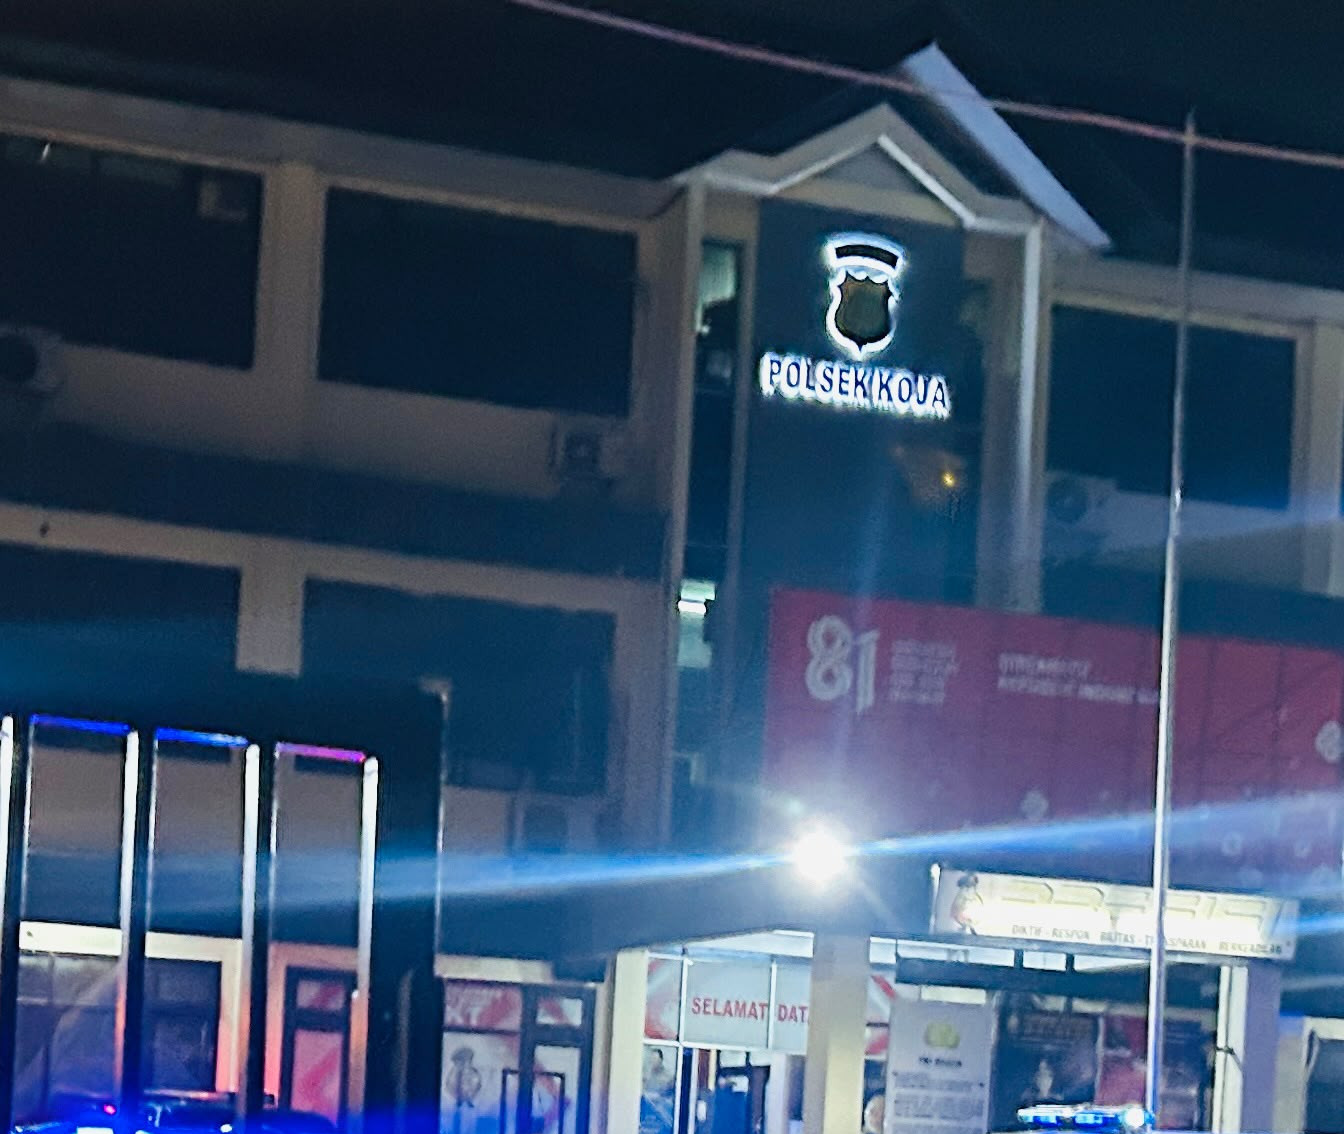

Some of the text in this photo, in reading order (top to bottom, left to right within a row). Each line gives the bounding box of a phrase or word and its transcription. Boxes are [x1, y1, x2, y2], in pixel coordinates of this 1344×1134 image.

[762, 353, 950, 418] POLSEK KOJA
[806, 614, 879, 716] 81
[691, 997, 769, 1021] SELAMAT
